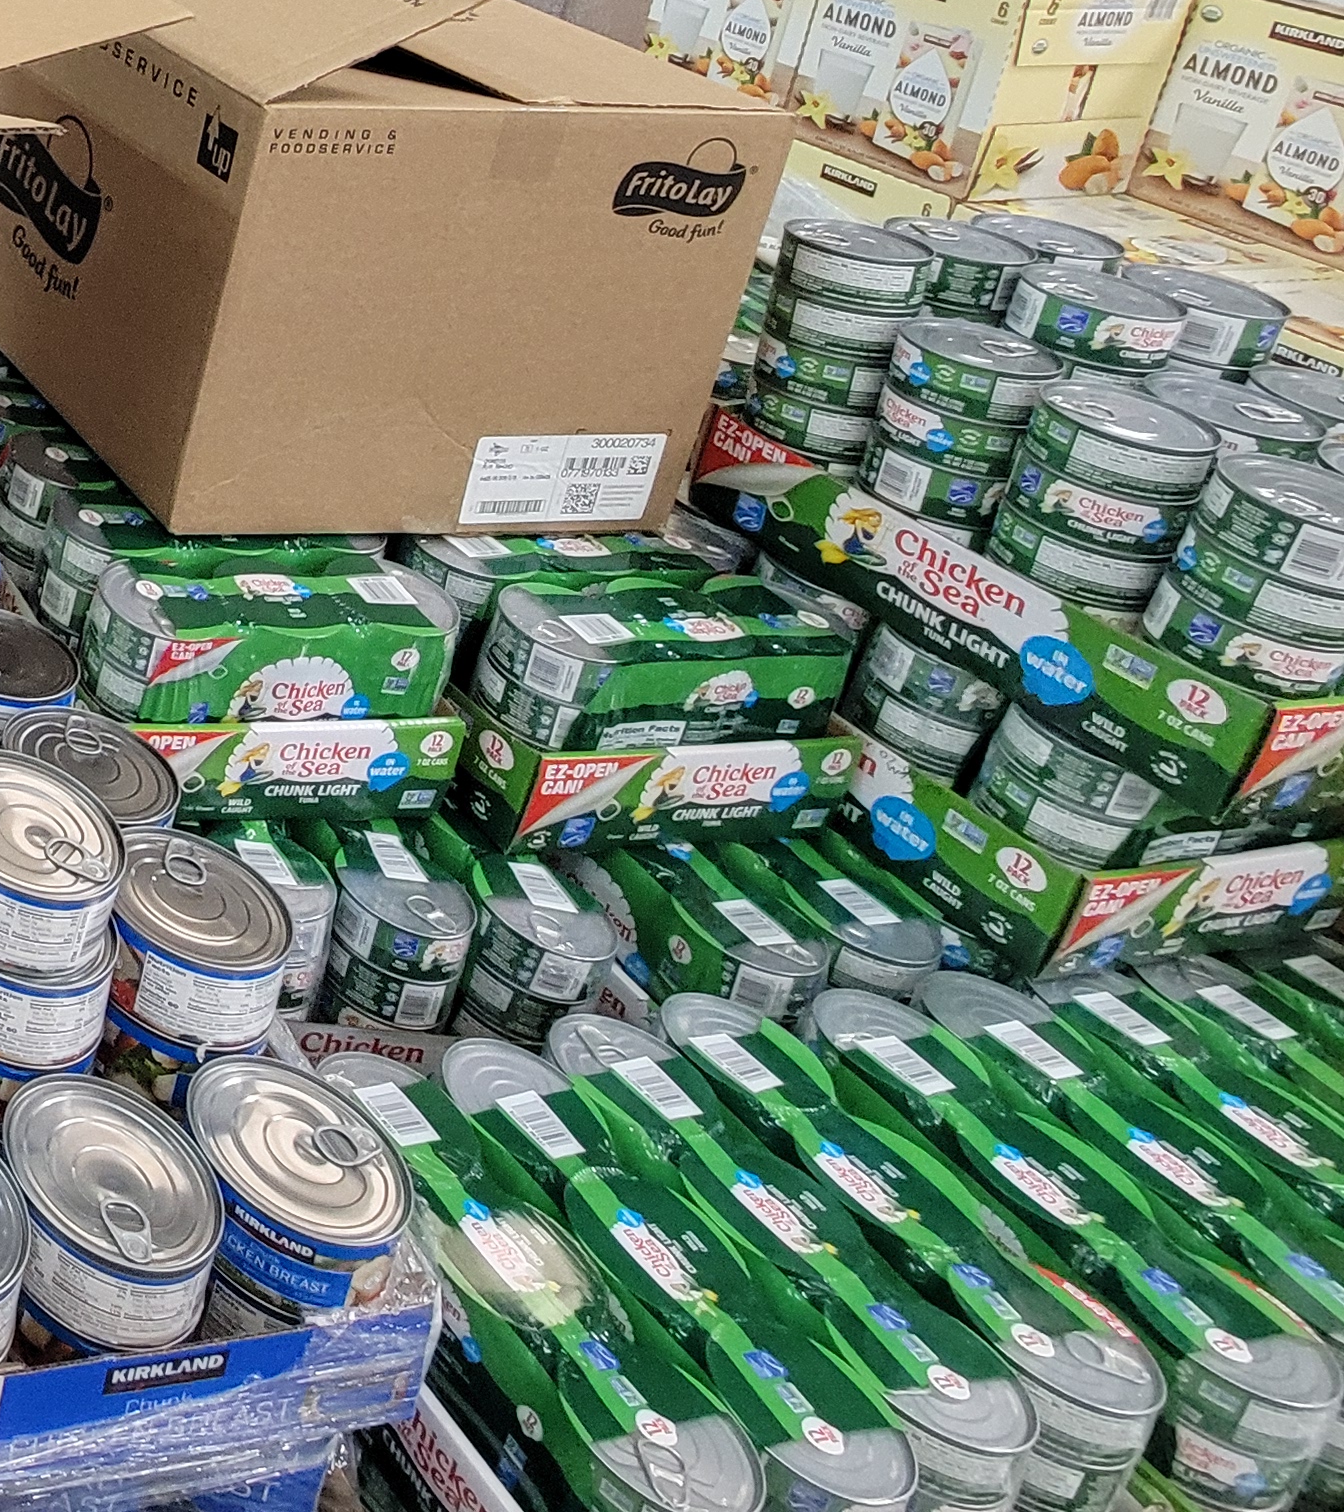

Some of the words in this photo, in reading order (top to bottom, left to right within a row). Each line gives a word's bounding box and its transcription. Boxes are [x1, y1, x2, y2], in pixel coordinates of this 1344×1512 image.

[822, 1, 898, 39] ALMOND
[998, 0, 1011, 17] 6
[1077, 10, 1134, 28] ALMOND
[725, 21, 768, 45] ALMOND
[1274, 23, 1344, 51] KIRKLAND
[831, 35, 872, 57] Vanilla
[1214, 39, 1267, 60] ORGANIC
[1182, 52, 1280, 95] ALMOND
[894, 79, 947, 107] ALMOND
[1192, 87, 1245, 115] Vanilla
[273, 128, 372, 141] VENDING
[386, 127, 398, 141] &
[210, 144, 231, 177] up
[269, 143, 397, 156] FOODSERVICE
[1272, 140, 1340, 172] ALMOND
[623, 170, 734, 210] FritoLay
[823, 163, 876, 194] KIRKLAND
[647, 219, 687, 240] Good
[688, 219, 725, 244] fun!
[11, 224, 48, 278] Good
[42, 260, 82, 302] fun!
[884, 397, 928, 429] Chicken
[591, 437, 657, 449] 300020734
[712, 431, 753, 465] CAN!
[718, 412, 787, 465] EZ-OPEN
[1077, 495, 1145, 524] Chicken
[1090, 508, 1124, 529] Sea
[894, 528, 1027, 620] Chicken
[897, 564, 918, 585] the
[918, 567, 982, 619] Sea
[875, 580, 951, 634] CHUNK
[948, 617, 1012, 672] LIGHT
[922, 627, 953, 652] TUNA
[1026, 651, 1089, 696] water
[271, 681, 346, 699] Chicken
[273, 706, 288, 715] the
[289, 699, 324, 715] Sea
[343, 706, 368, 717] water
[1080, 720, 1129, 753] CAUGHT
[1091, 711, 1127, 739] WILD
[432, 734, 444, 747] 12
[490, 735, 504, 755] 12
[279, 743, 372, 764] Chicken
[386, 759, 396, 767] IN
[281, 767, 297, 776] the
[298, 761, 341, 777] Sea
[370, 764, 406, 777] water
[544, 762, 619, 780] EZ-OPEN
[692, 763, 777, 786] Chicken
[264, 784, 323, 797] CHUNK
[325, 784, 361, 797] LIGHT
[539, 779, 583, 796] CAN!
[710, 781, 748, 800] Sea
[220, 804, 254, 815] CAUGHT
[227, 797, 252, 807] WILD
[671, 807, 720, 822] CHUNK
[719, 804, 763, 820] LIGHT
[875, 808, 930, 852] water
[1013, 851, 1034, 876] 12
[922, 877, 964, 911] CAUGHT
[931, 869, 962, 897] WILD
[1089, 878, 1162, 901] EZ-OPEN
[1225, 869, 1304, 894] Chicken
[299, 1031, 425, 1065] Chicken
[234, 1204, 315, 1259] KIRKLAND
[111, 1354, 225, 1384] KIRKLAND
